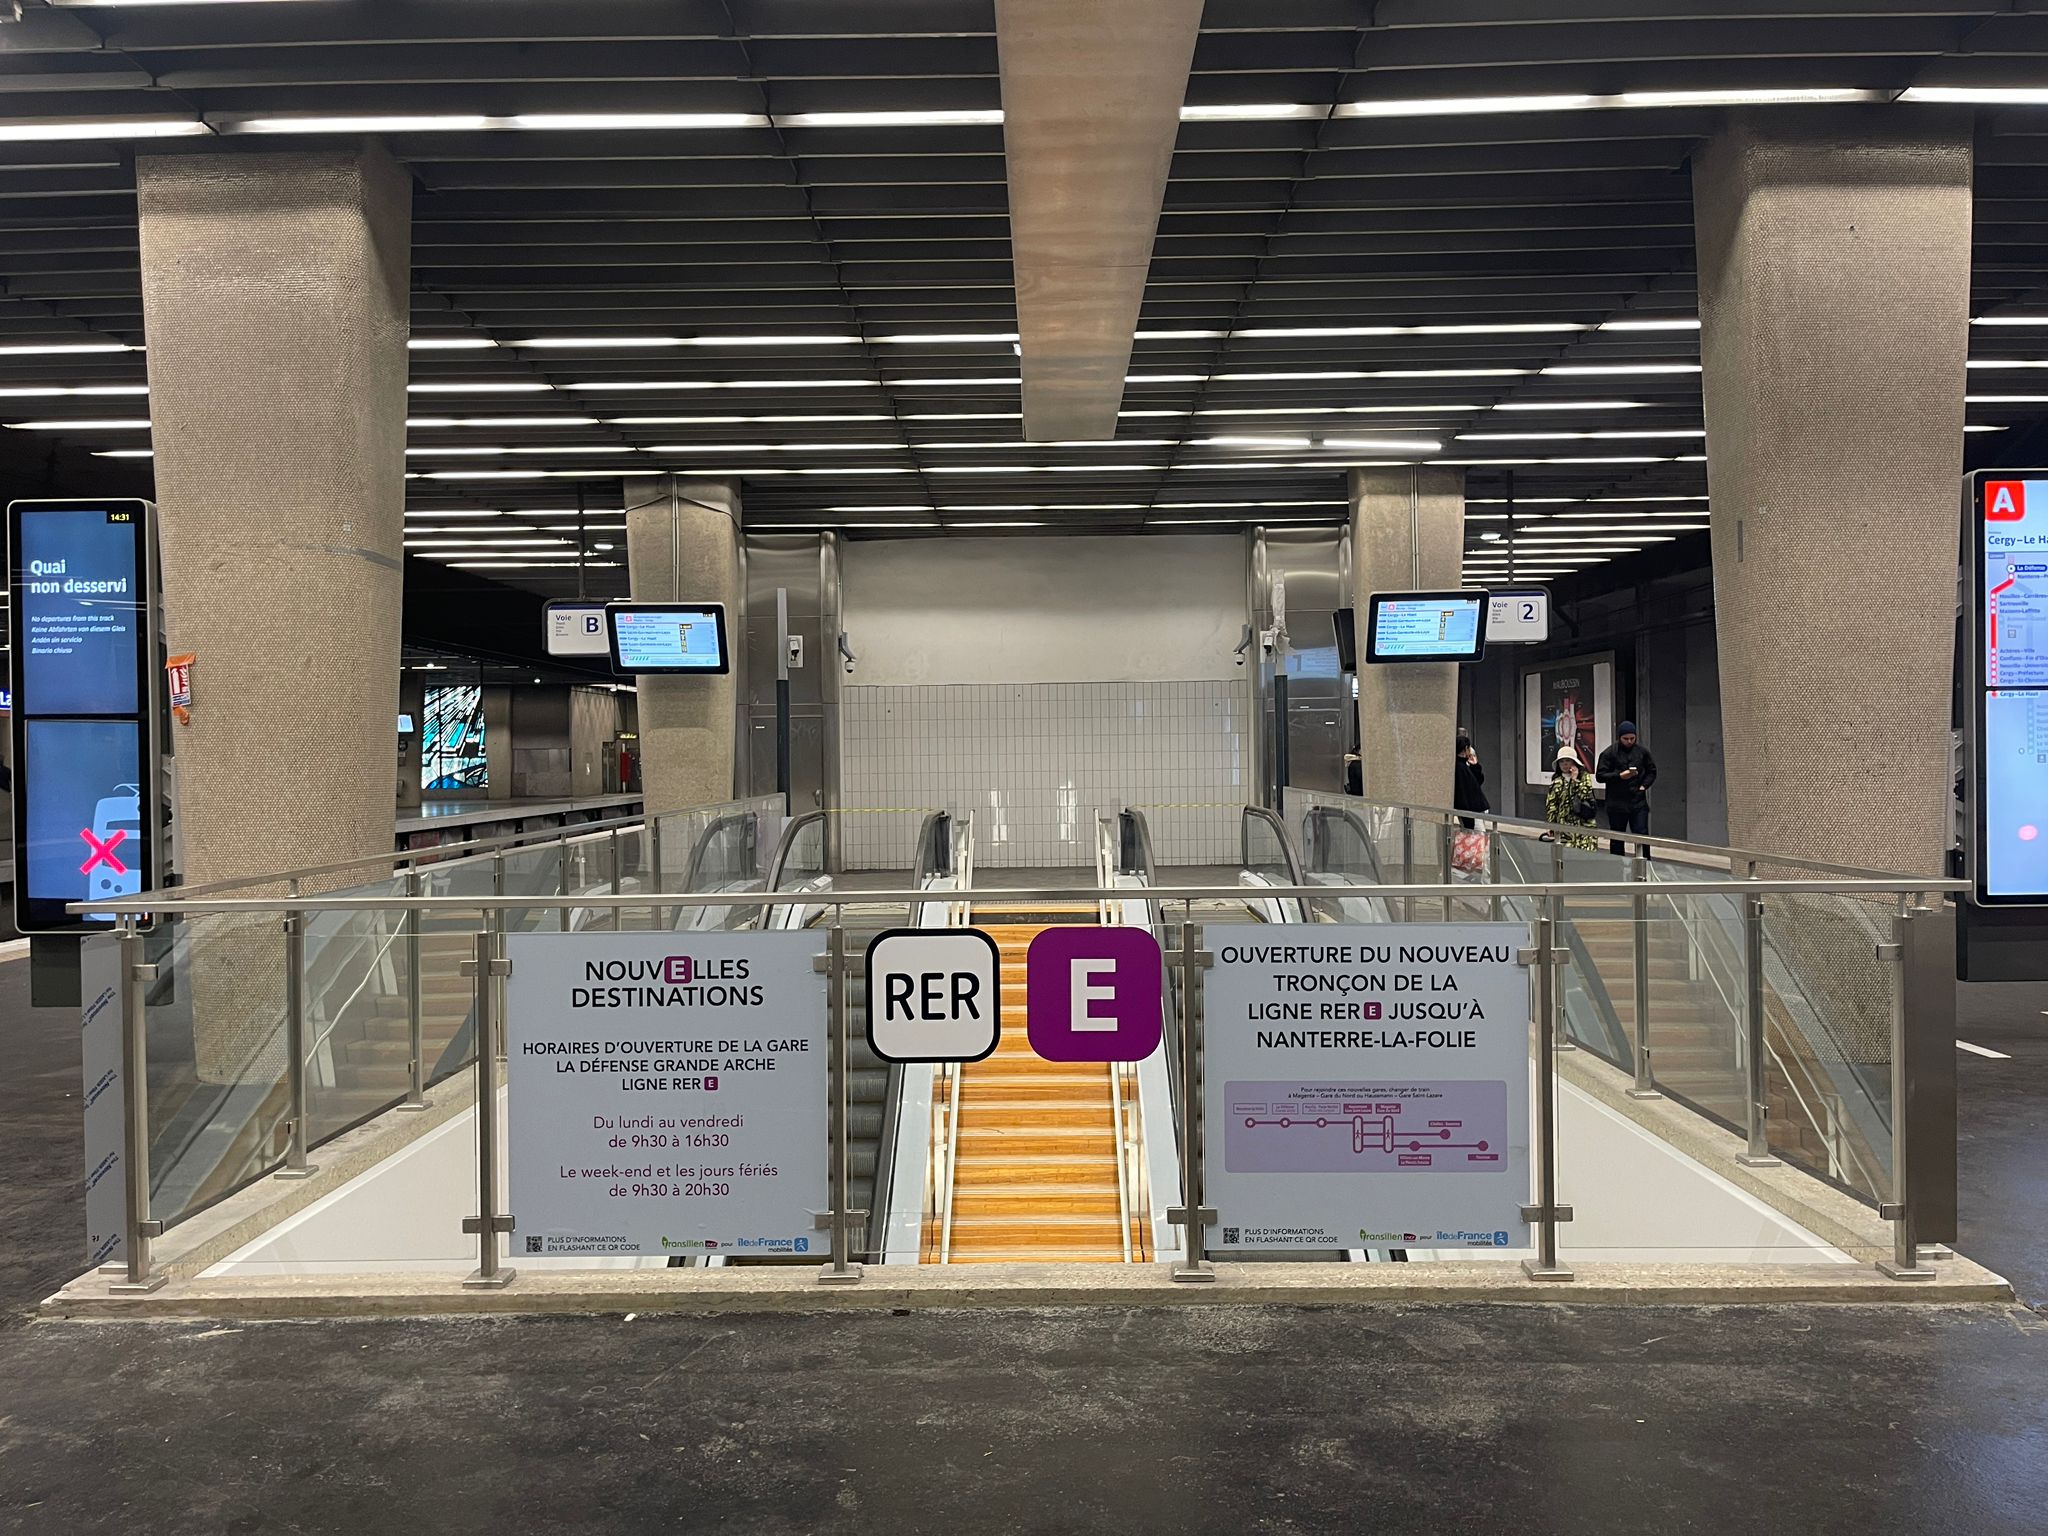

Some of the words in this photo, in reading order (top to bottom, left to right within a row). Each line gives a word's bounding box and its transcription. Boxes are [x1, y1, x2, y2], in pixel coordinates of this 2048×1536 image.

[1992, 487, 2015, 512] A
[30, 559, 66, 576] Quai
[31, 581, 60, 593] non
[64, 578, 127, 593] desservi
[1523, 603, 1534, 620] 2
[586, 617, 599, 632] B
[1222, 947, 1352, 963] OUVERTURE
[1361, 947, 1391, 963] DU
[1400, 946, 1509, 963] NOUVEAU
[586, 959, 749, 981] NOUVELLES
[1273, 975, 1386, 996] TRONÇON
[1395, 975, 1423, 991] DE
[1431, 975, 1458, 991] LA
[572, 986, 764, 1008] DESTINATIONS
[886, 972, 980, 1021] RER
[1070, 958, 1118, 1032] E
[1249, 1003, 1312, 1020] LIGNE
[1321, 1003, 1360, 1020] RER
[1388, 998, 1484, 1020] JUSQU'À
[523, 1042, 599, 1055] HORAIRES
[605, 1041, 713, 1054] D'OUVERTURE
[718, 1040, 738, 1052] DE
[744, 1040, 762, 1052] LA
[767, 1040, 808, 1052] GARE
[1257, 1031, 1475, 1048] NANTERRE-LA-FOLIE
[557, 1061, 575, 1073] LA
[580, 1058, 648, 1072] DÉFENSE
[654, 1059, 719, 1072] GRANDE
[724, 1059, 775, 1071] ARCHE
[622, 1078, 667, 1091] LIGNE
[673, 1078, 701, 1090] RER
[594, 1116, 614, 1128] Du
[619, 1115, 654, 1128] lundi
[659, 1120, 675, 1128] au
[680, 1115, 743, 1128] vendredi
[609, 1135, 626, 1147] de
[632, 1135, 667, 1147] 9h30
[672, 1135, 679, 1147] à
[686, 1134, 729, 1147] 16h30
[560, 1166, 576, 1178] Le
[581, 1164, 651, 1178] week-end
[657, 1166, 670, 1177] et
[676, 1164, 695, 1177] les
[699, 1165, 734, 1180] jours
[739, 1163, 778, 1176] fériés
[609, 1184, 627, 1197] de
[632, 1184, 667, 1196] 9h30
[672, 1184, 679, 1196] à
[685, 1183, 729, 1196] 20h30
